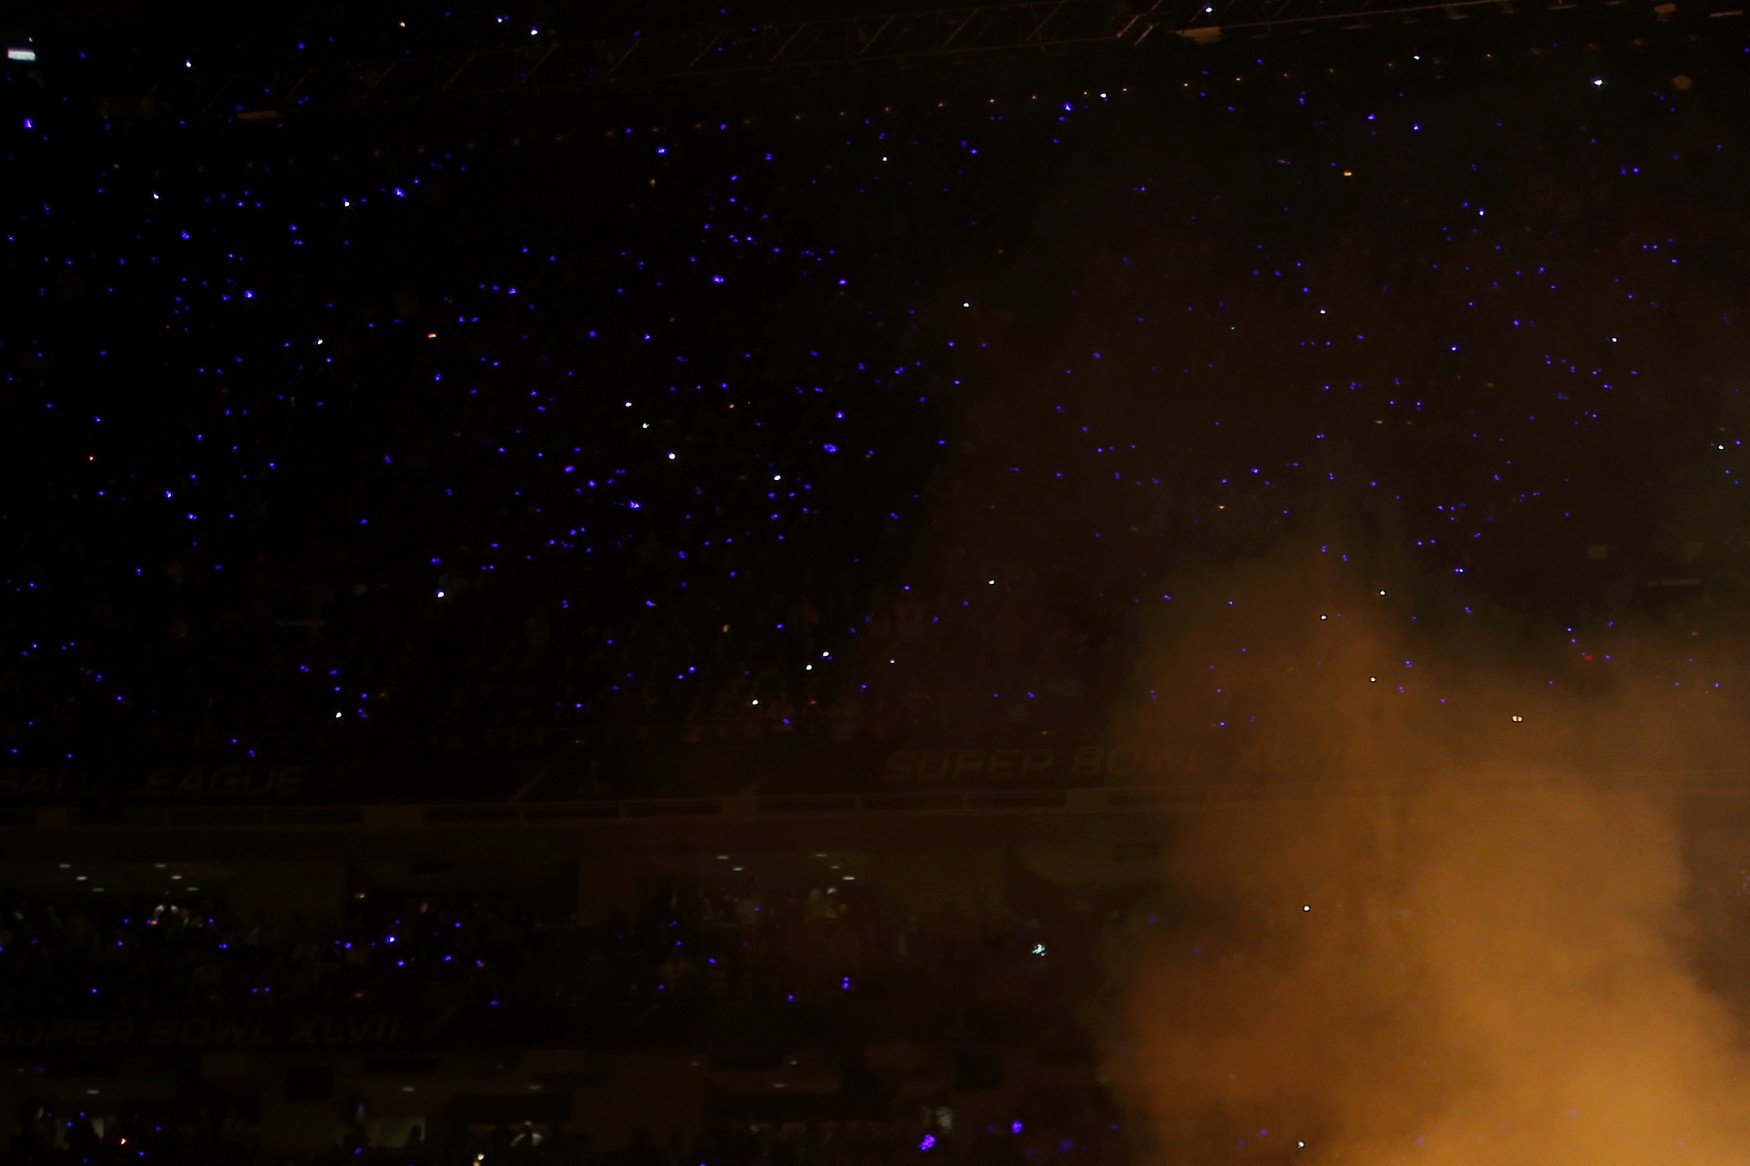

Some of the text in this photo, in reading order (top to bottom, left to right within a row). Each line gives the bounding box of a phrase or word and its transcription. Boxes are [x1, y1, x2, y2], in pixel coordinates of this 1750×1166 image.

[881, 747, 1054, 784] SUPER
[1070, 744, 1207, 776] BOWL
[147, 1017, 274, 1047] BOWL
[287, 1014, 402, 1046] XLVII
